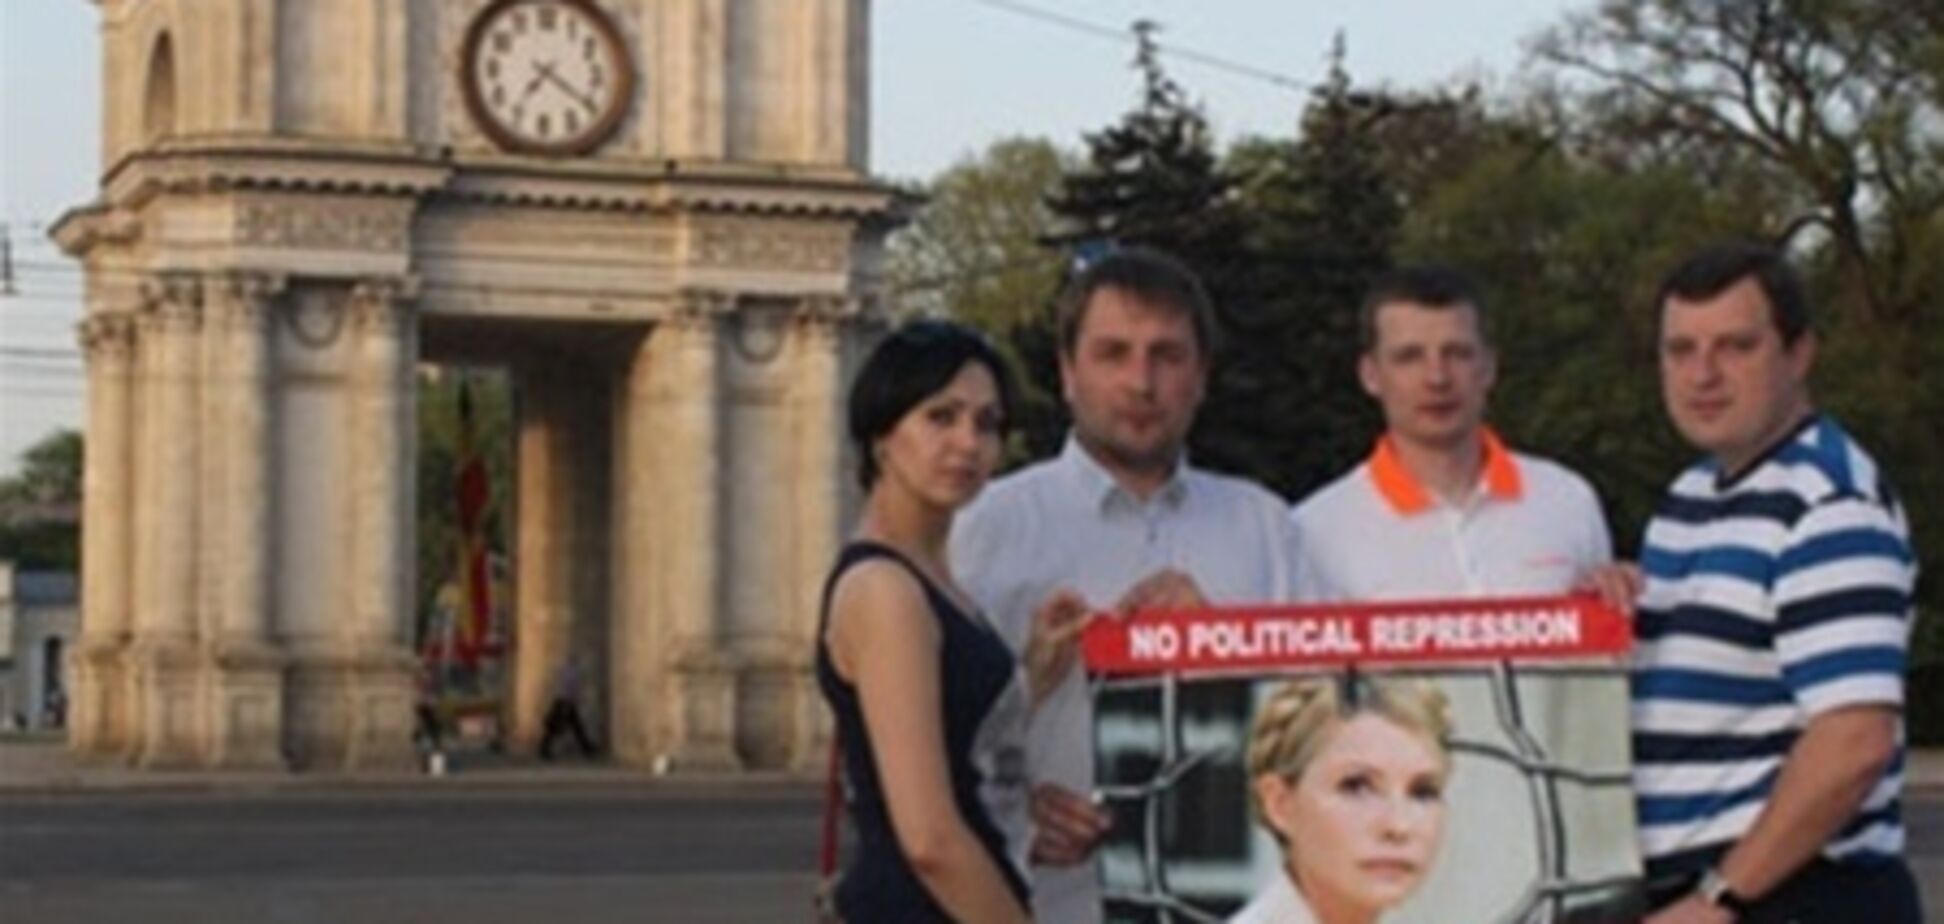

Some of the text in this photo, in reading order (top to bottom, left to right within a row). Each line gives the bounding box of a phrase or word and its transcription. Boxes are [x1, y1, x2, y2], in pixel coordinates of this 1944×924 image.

[1128, 608, 1581, 660] NO POLITICAL REPRESSION
